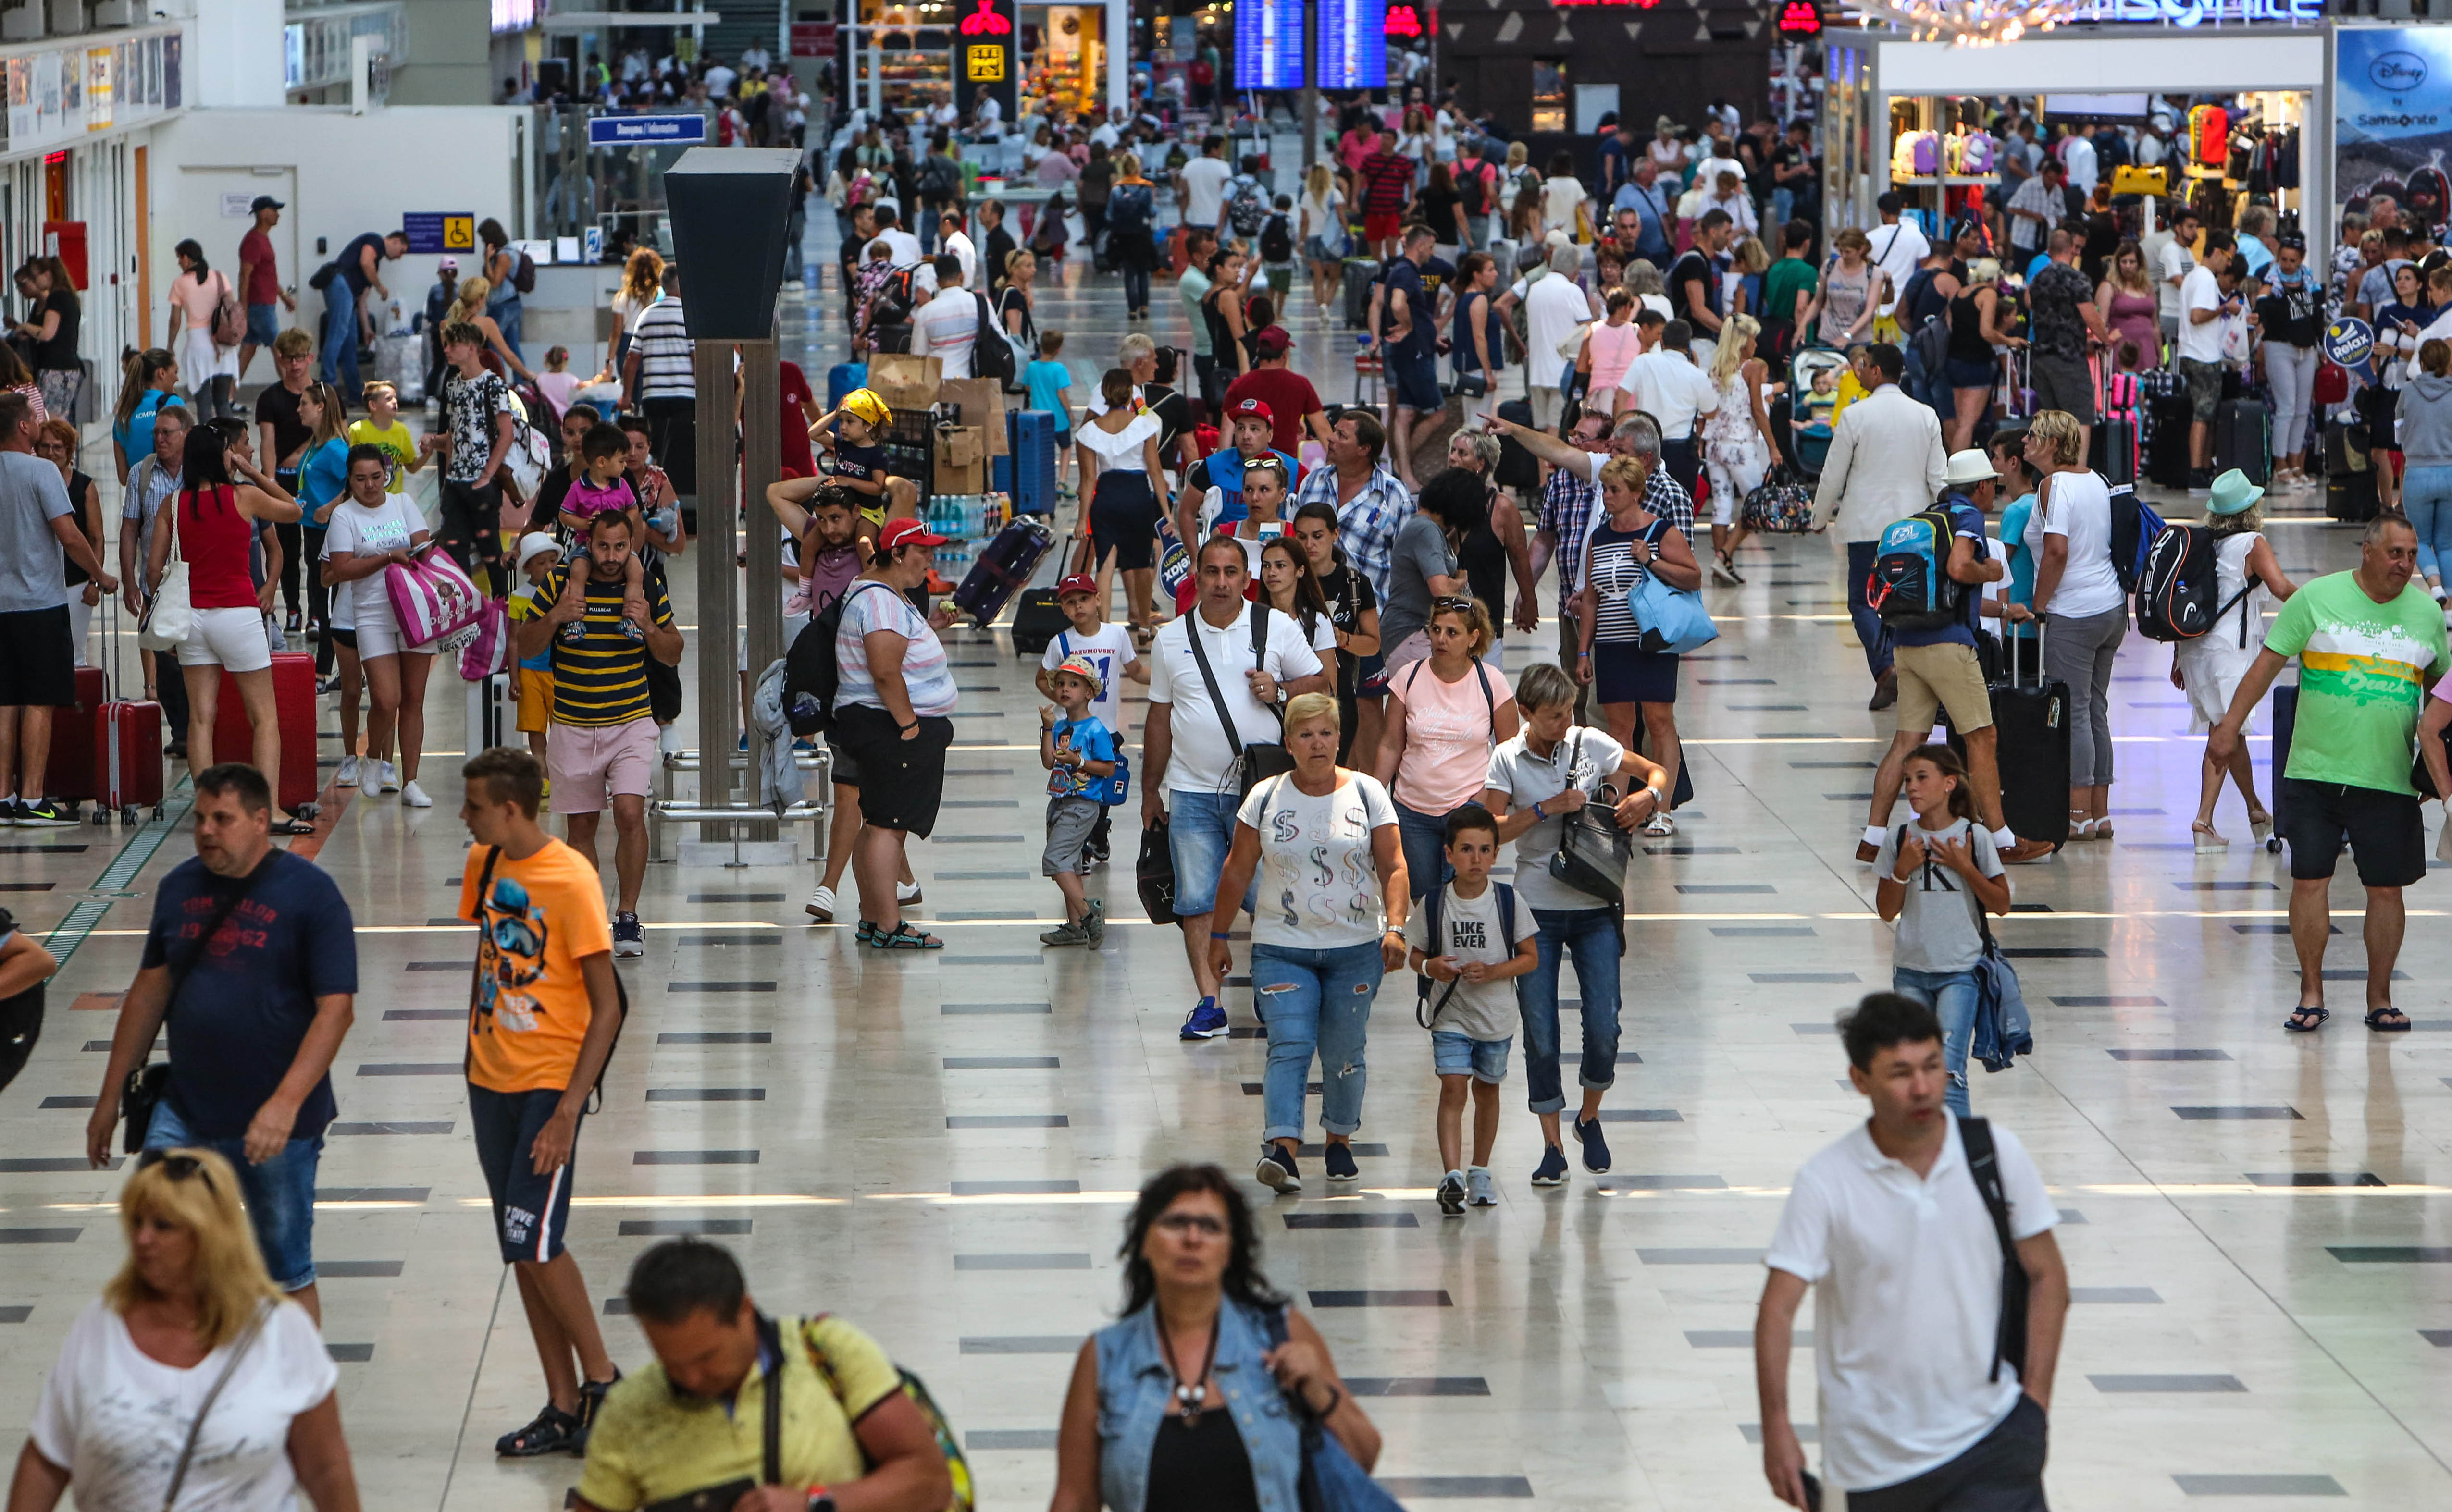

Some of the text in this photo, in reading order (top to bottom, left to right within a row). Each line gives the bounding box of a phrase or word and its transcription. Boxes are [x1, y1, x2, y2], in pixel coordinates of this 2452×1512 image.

[2358, 113, 2438, 127] Samsonite
[2333, 333, 2369, 359] Relax
[135, 410, 157, 419] KOMPA
[2144, 528, 2175, 617] HEAD
[1452, 921, 1485, 935] LIKE
[1453, 935, 1486, 949] EVER
